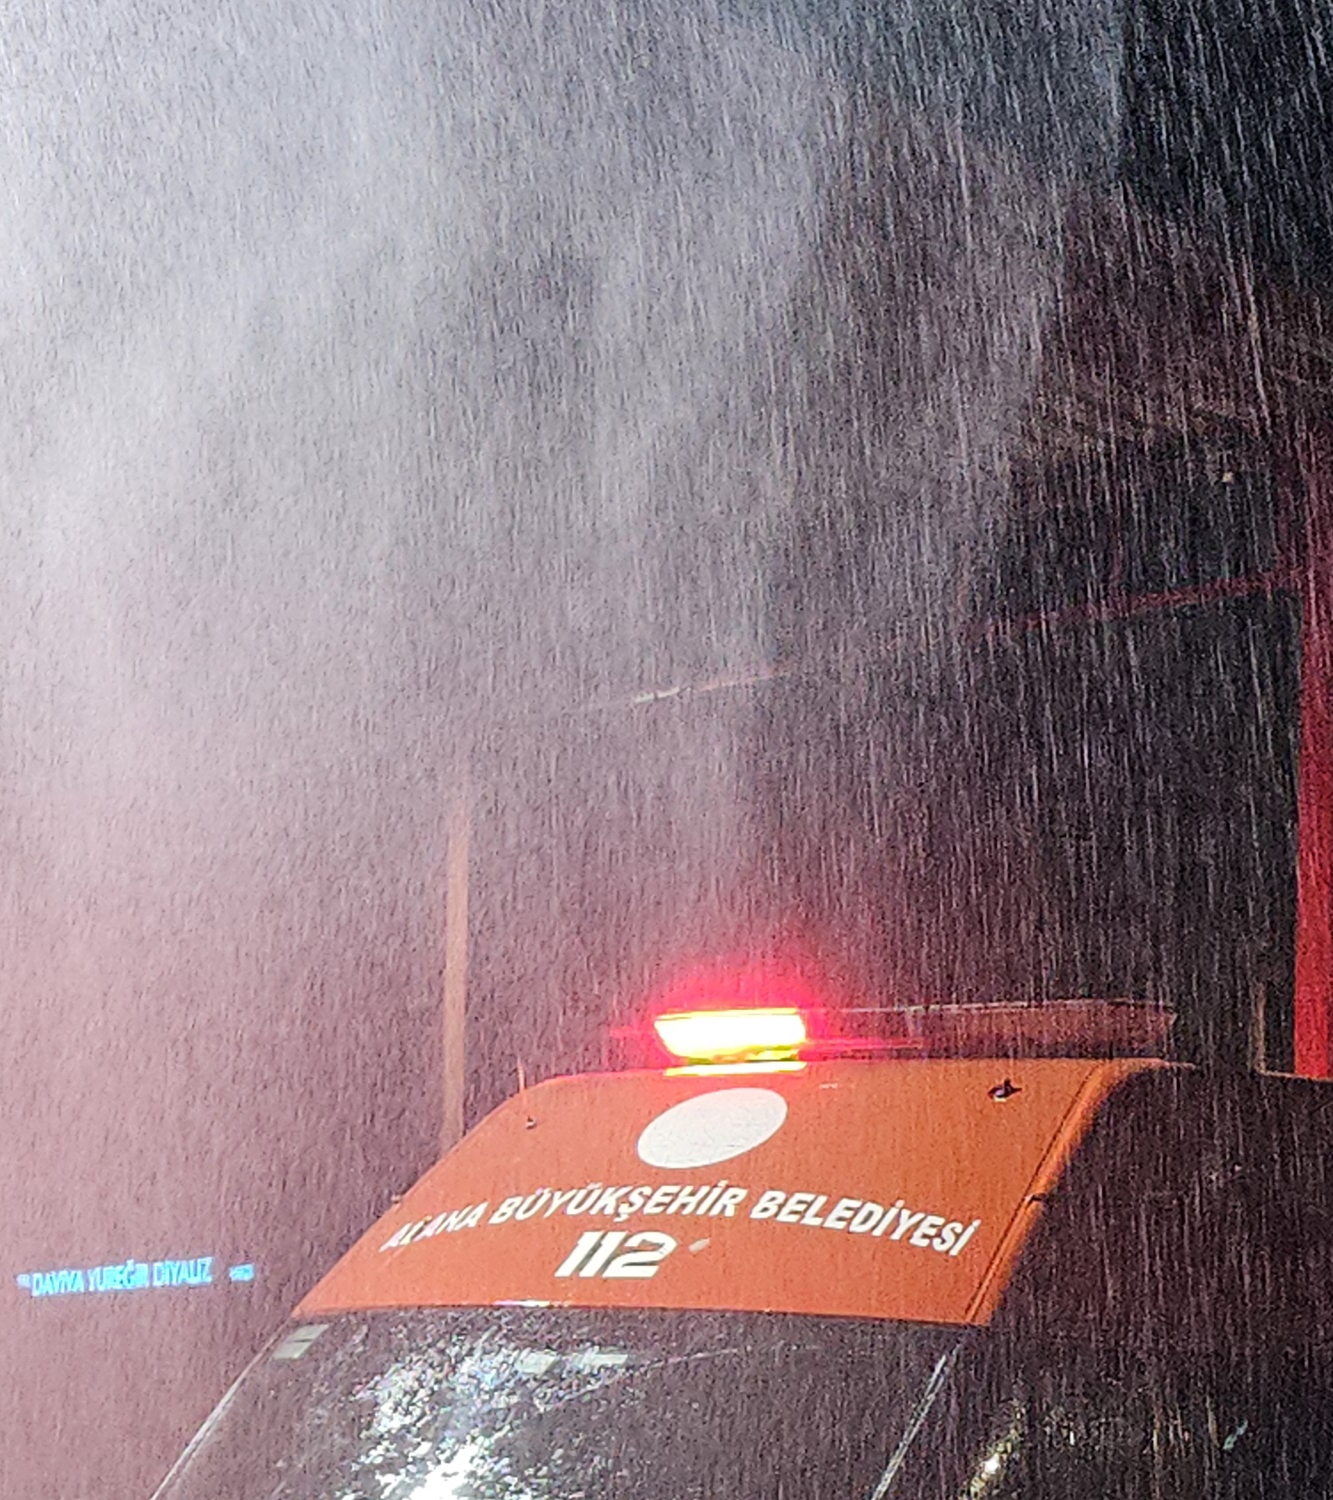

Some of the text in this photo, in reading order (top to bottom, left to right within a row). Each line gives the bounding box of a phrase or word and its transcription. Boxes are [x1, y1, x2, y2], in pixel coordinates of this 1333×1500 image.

[488, 1179, 748, 1223] BÜYÜKŞEHİR
[749, 1190, 982, 1257] BELEDİYESİ
[553, 1230, 678, 1278] 112
